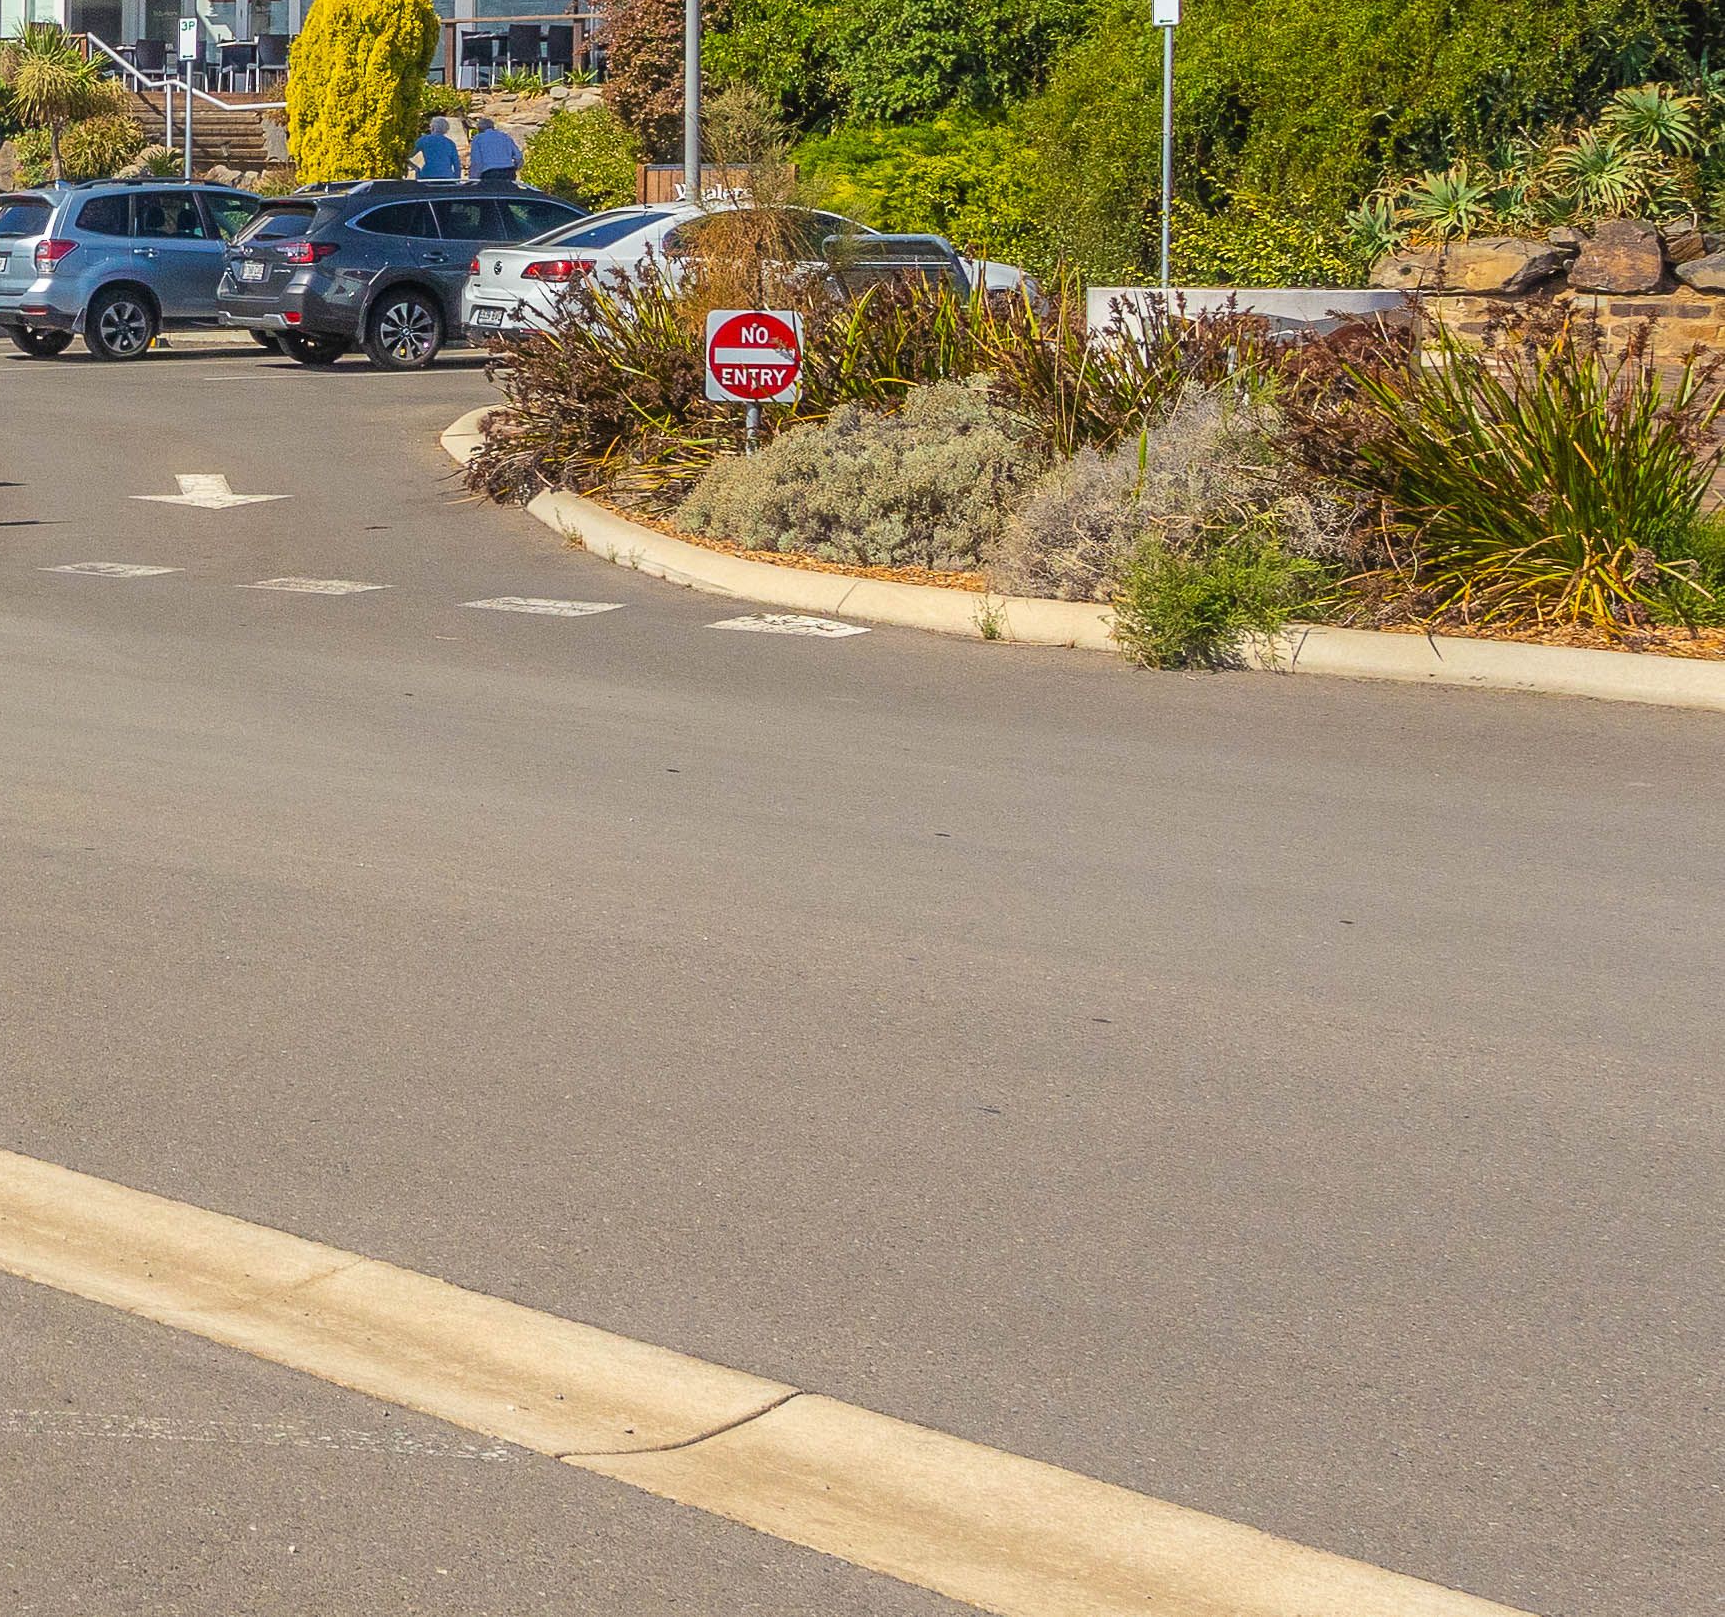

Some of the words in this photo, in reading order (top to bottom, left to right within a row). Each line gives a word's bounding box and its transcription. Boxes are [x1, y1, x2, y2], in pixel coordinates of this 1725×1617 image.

[181, 21, 196, 31] 3P
[741, 326, 769, 344] NO
[721, 367, 787, 386] ENTRY
